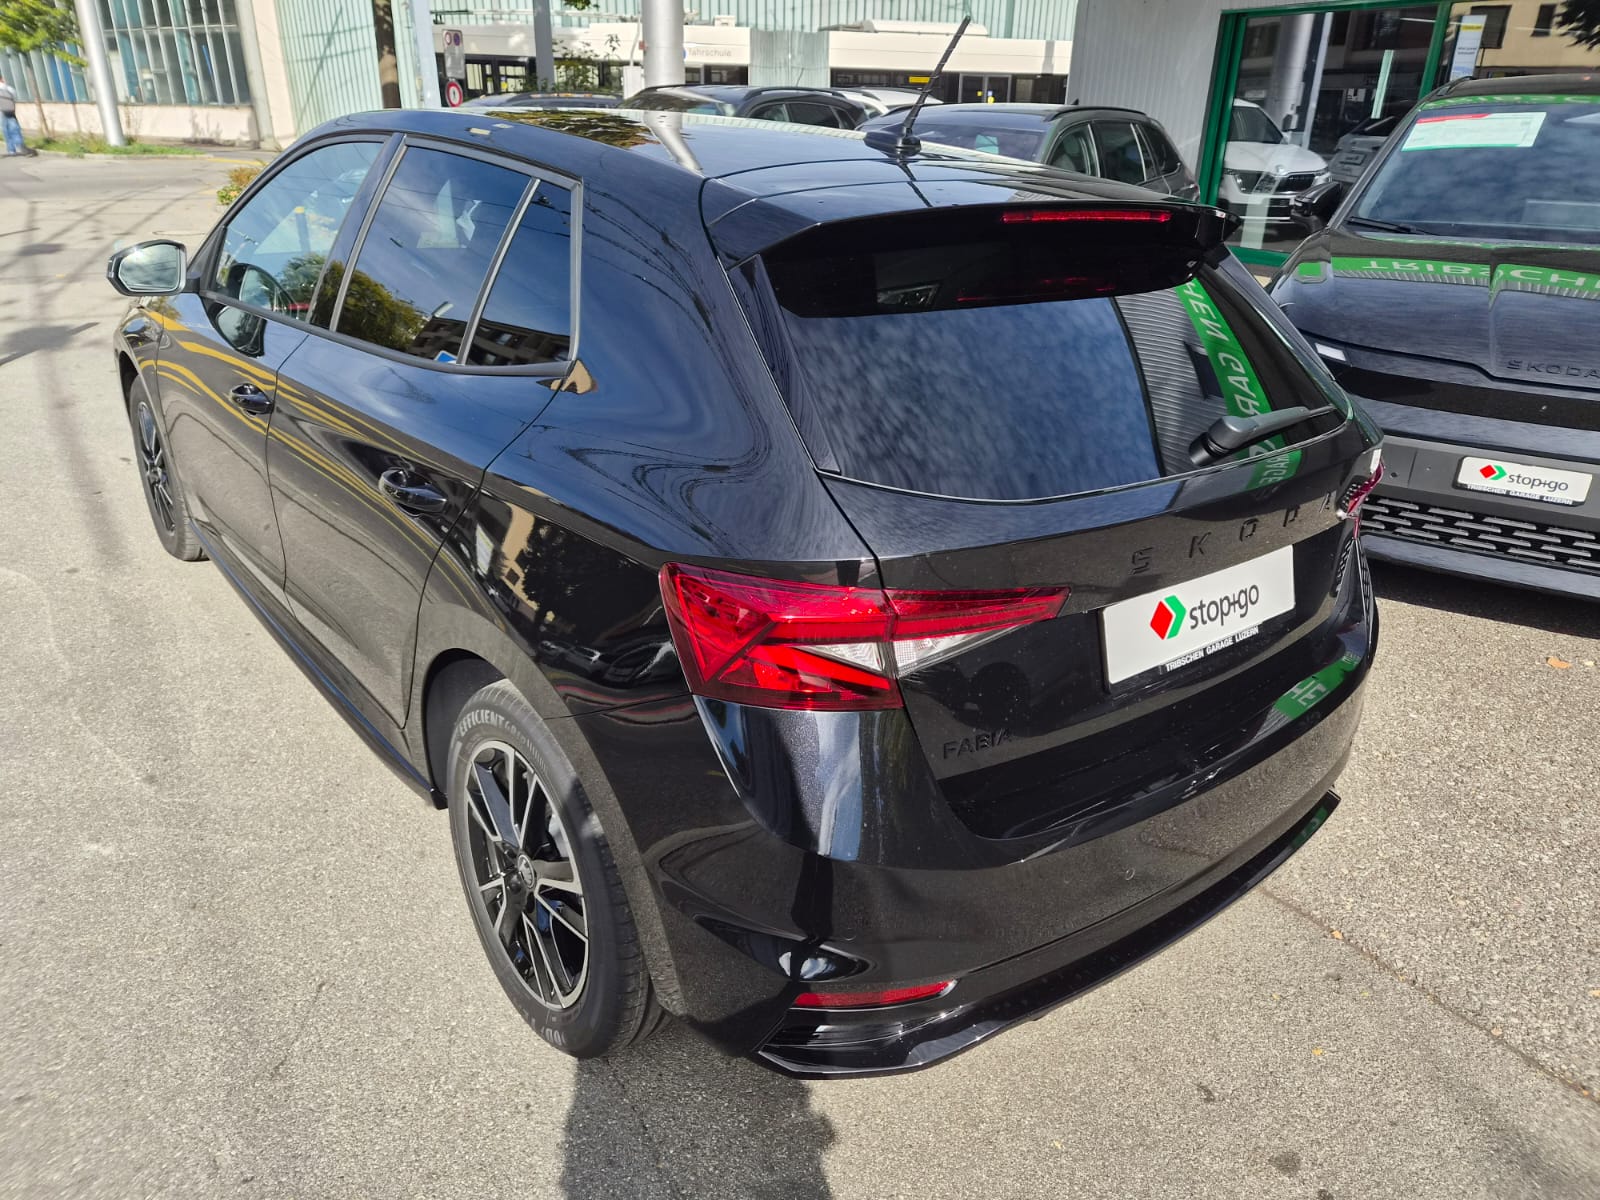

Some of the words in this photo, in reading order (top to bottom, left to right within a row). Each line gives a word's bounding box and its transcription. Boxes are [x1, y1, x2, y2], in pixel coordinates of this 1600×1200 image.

[1508, 473, 1569, 492] stop+go
[1189, 584, 1260, 630] stop+go
[1165, 649, 1205, 672] TRIBSCHEN
[1206, 635, 1234, 655] GARAGE
[1234, 625, 1260, 644] LUZERN
[459, 709, 505, 737] EFFICIENT
[943, 728, 1012, 759] FABIA
